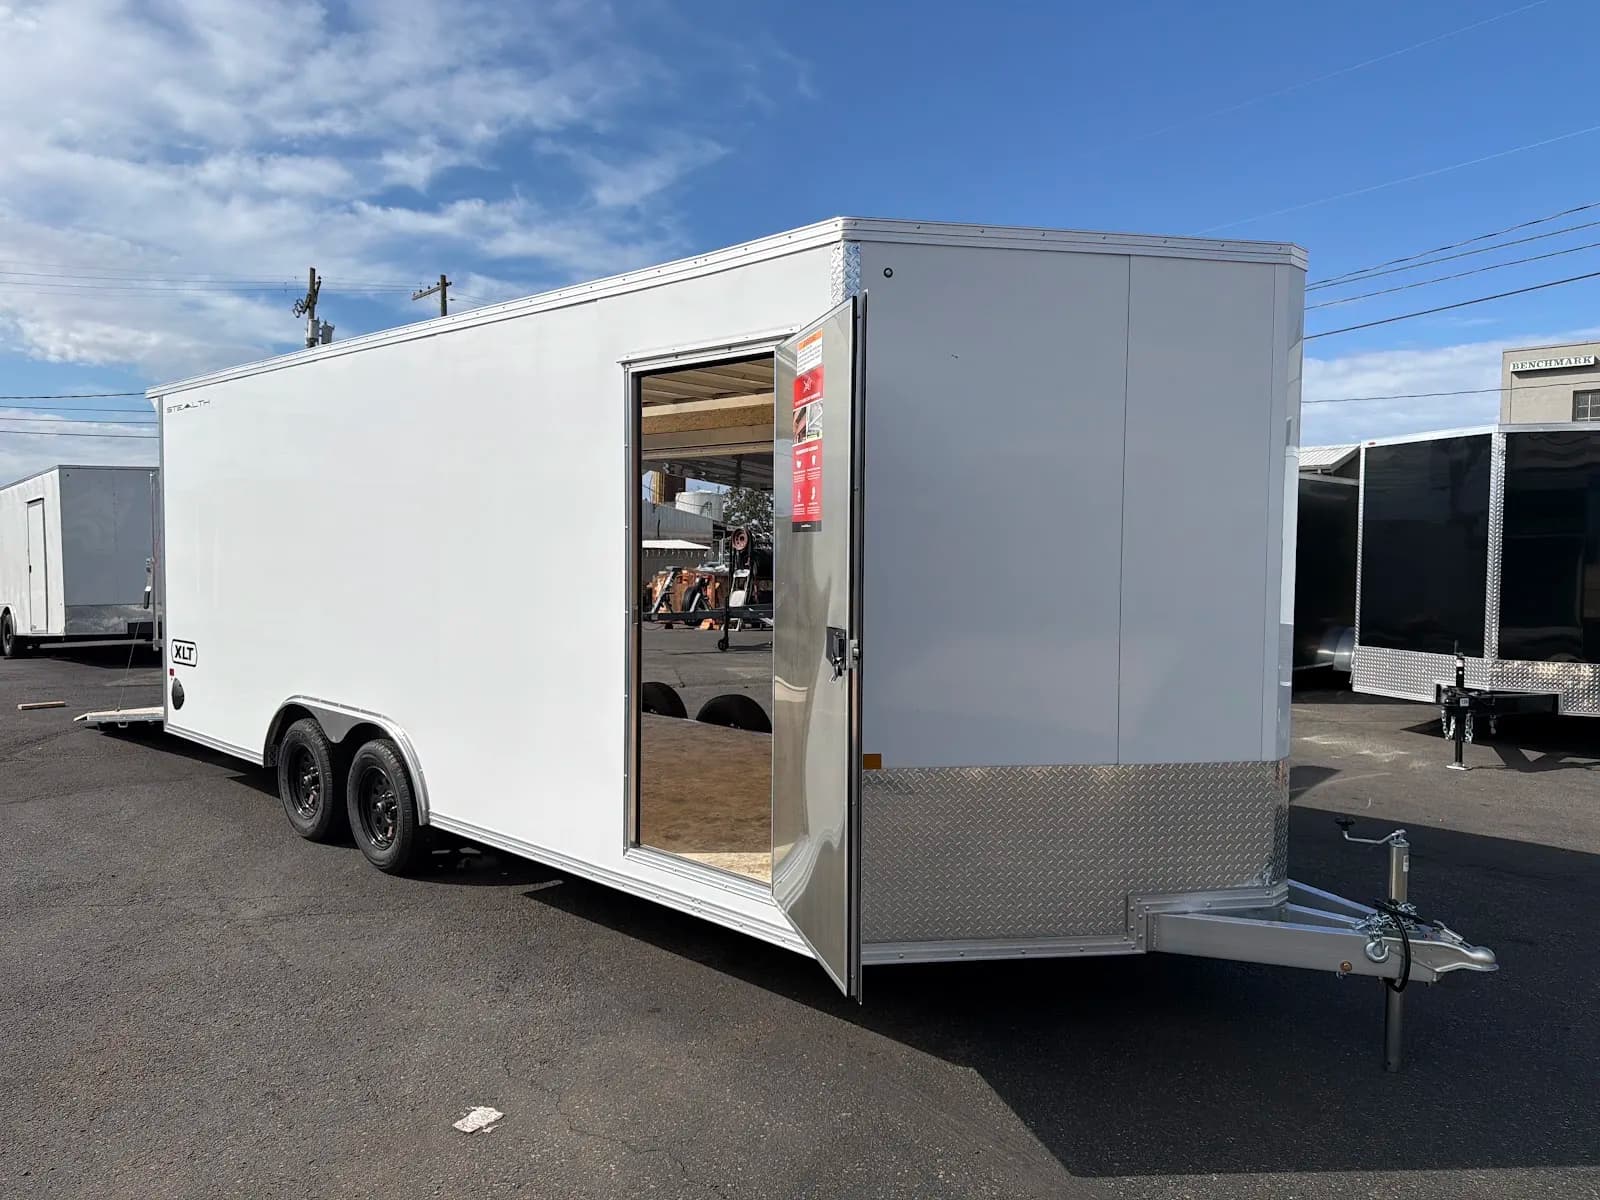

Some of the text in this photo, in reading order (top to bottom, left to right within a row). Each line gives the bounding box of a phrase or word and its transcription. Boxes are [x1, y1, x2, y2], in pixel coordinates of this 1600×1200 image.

[1512, 356, 1592, 371] BENCHMARK
[166, 399, 210, 413] STEALTH
[174, 645, 194, 661] XLT
